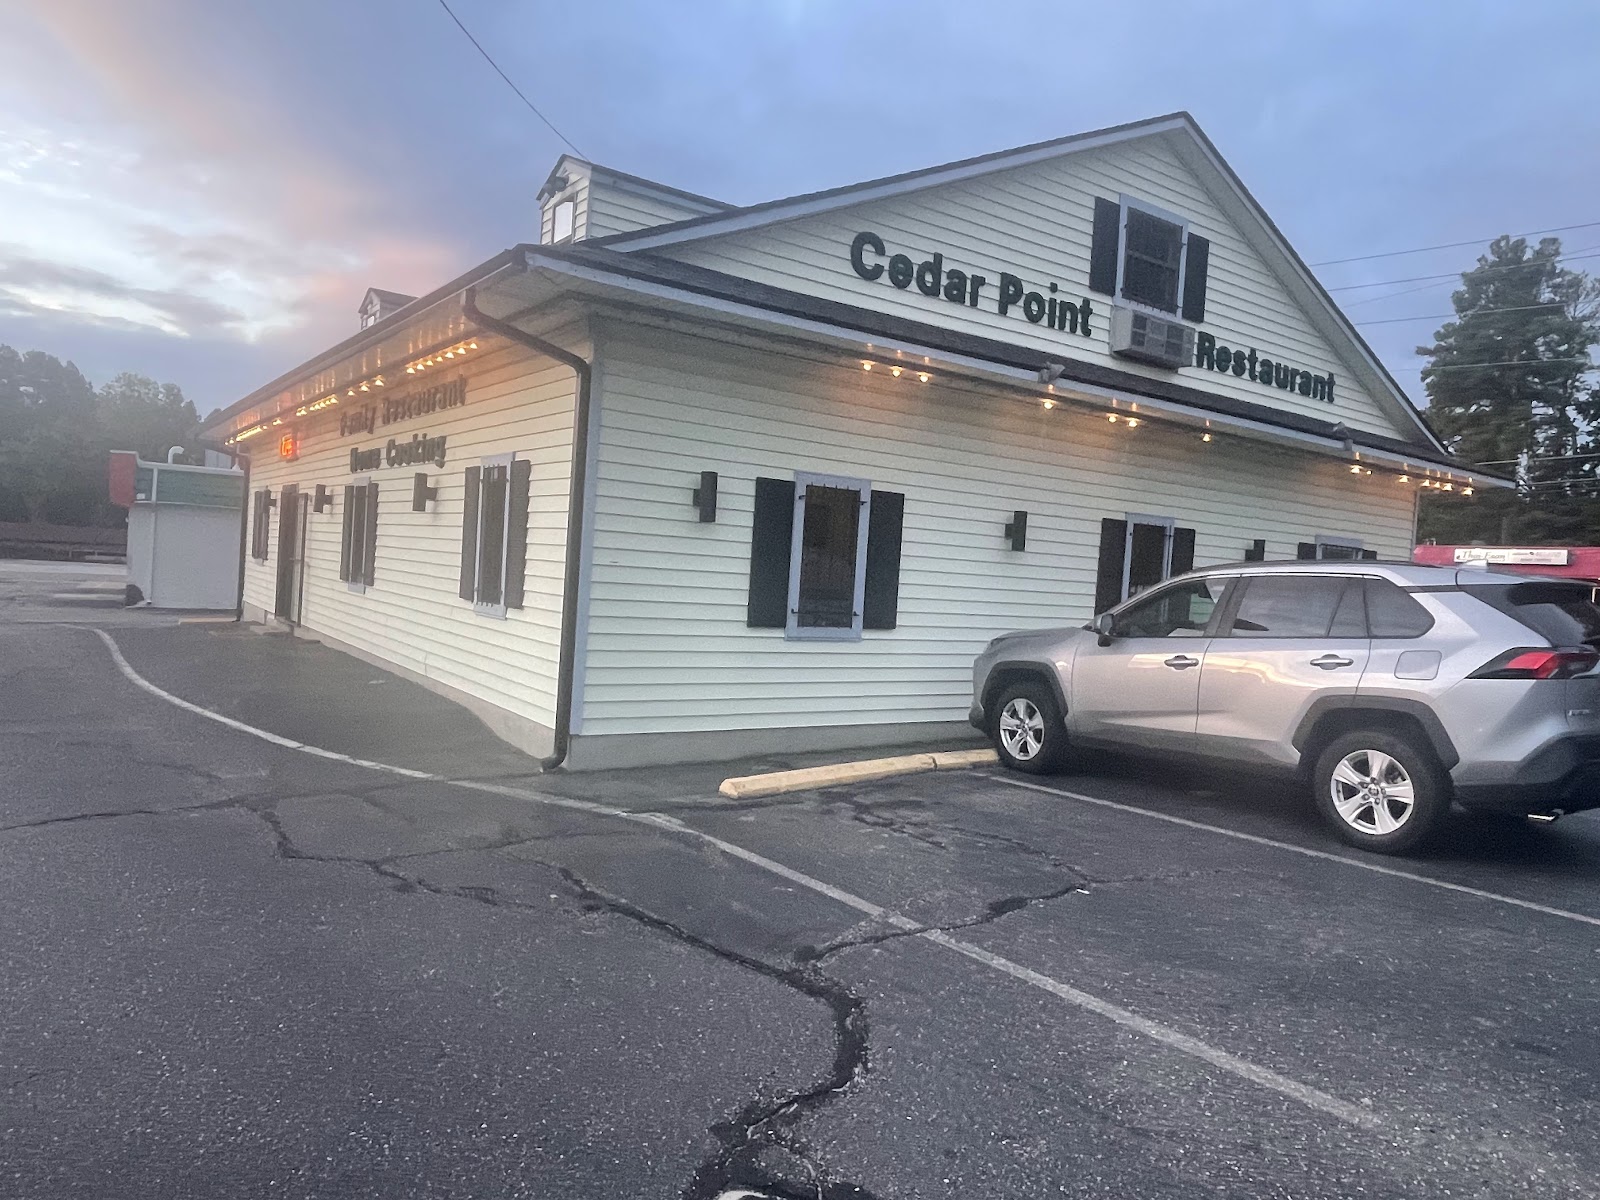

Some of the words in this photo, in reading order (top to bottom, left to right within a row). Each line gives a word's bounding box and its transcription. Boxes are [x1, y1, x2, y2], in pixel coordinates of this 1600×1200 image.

[850, 231, 986, 307] Cedar
[998, 271, 1093, 337] Point
[1196, 331, 1336, 403] Restaurant
[386, 433, 447, 469] Cooking
